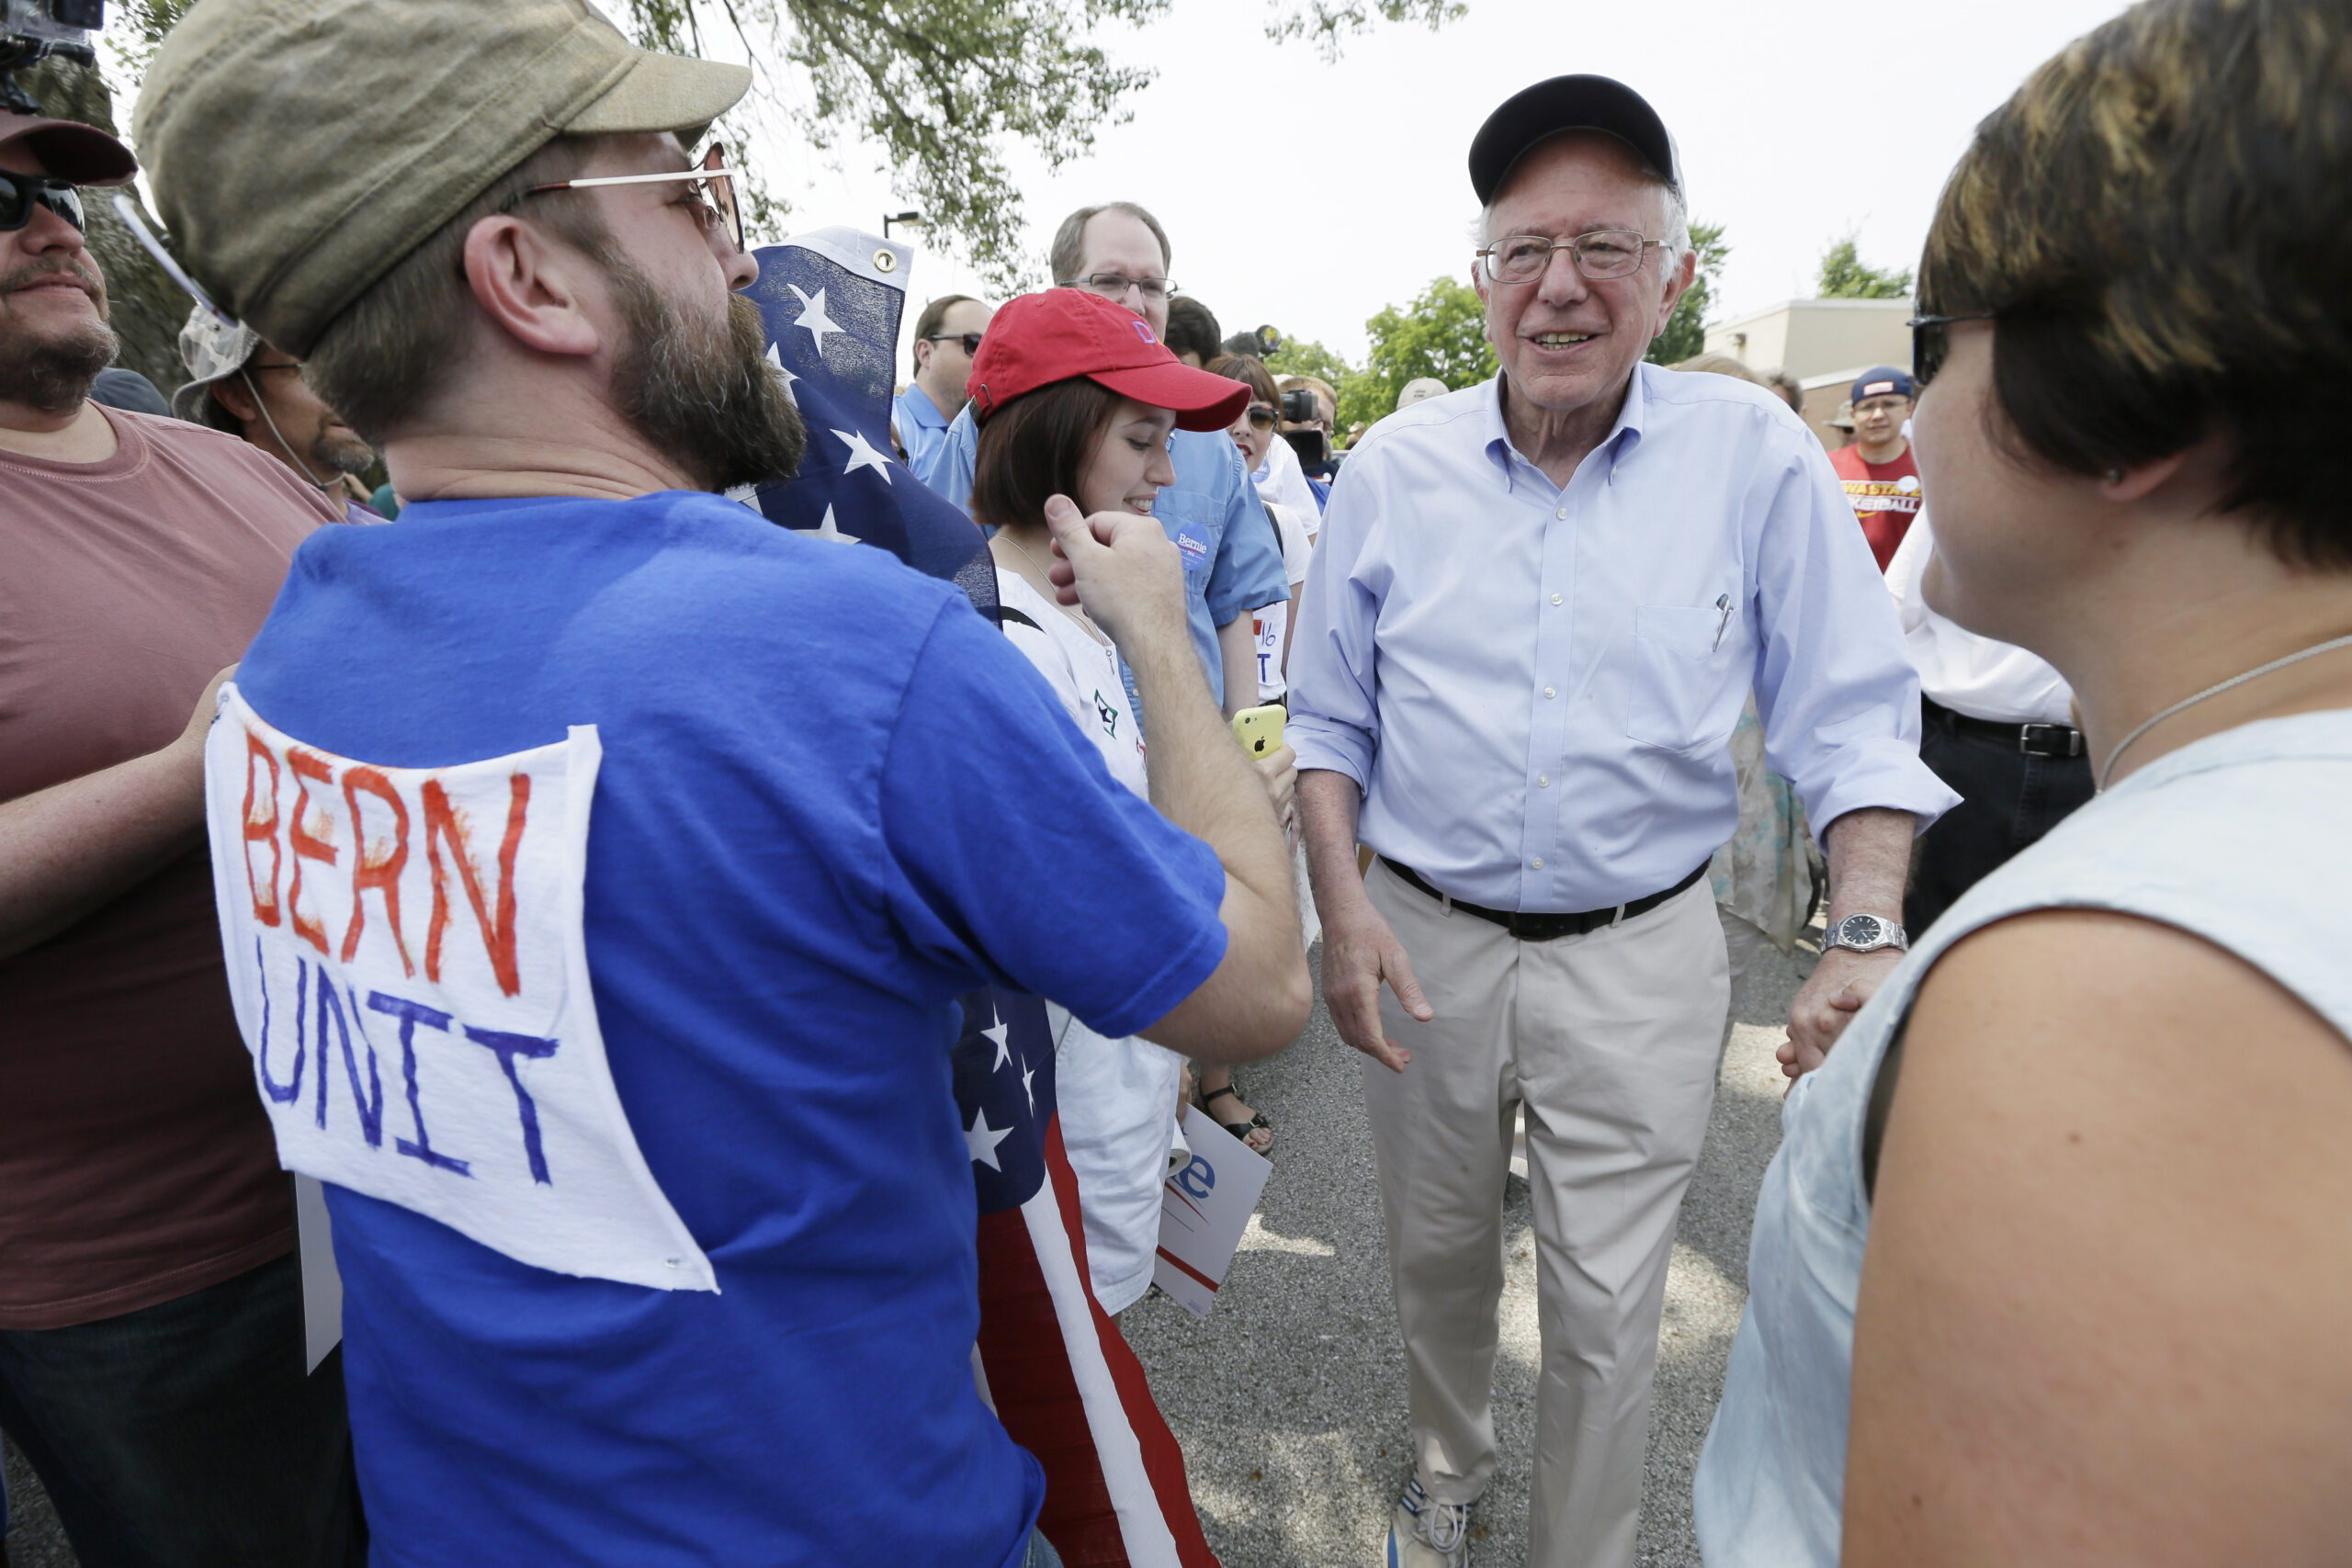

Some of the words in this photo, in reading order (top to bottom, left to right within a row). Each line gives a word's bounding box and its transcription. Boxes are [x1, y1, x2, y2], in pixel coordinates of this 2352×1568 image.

[1869, 483, 1922, 497] STAE
[1848, 496, 1917, 513] KETBALL
[1177, 533, 1207, 554] Bernie
[243, 730, 531, 998] BERN
[255, 933, 560, 1188] UNIT
